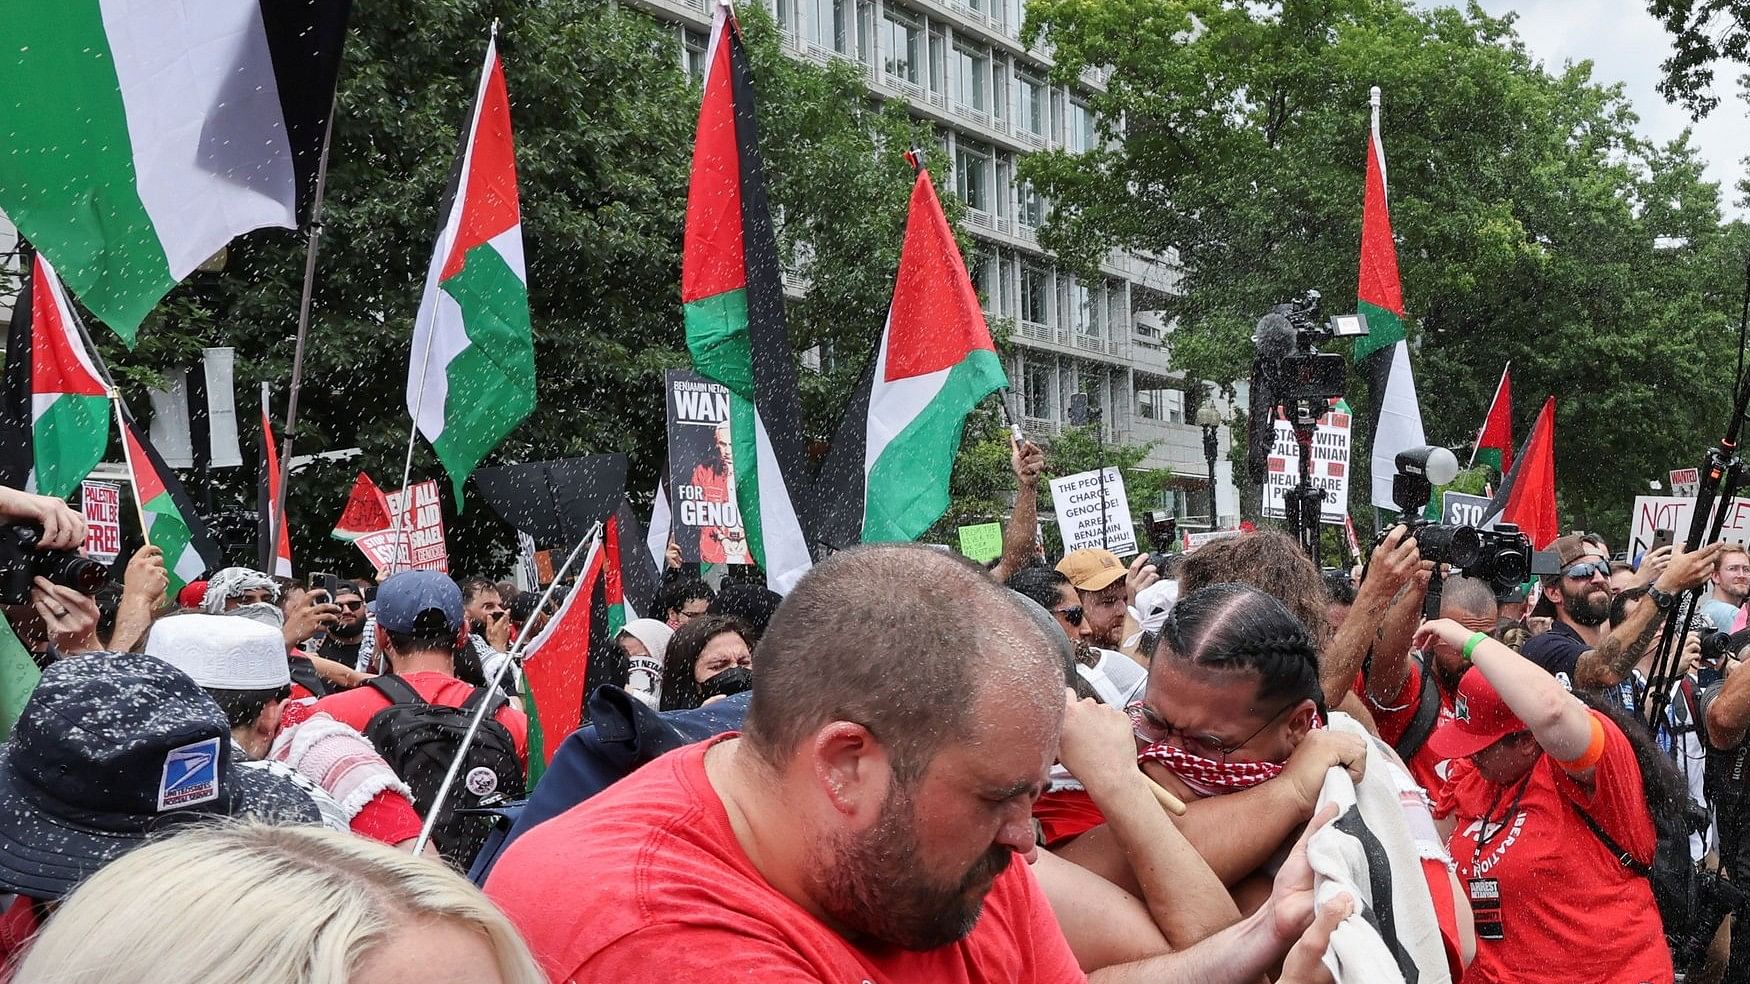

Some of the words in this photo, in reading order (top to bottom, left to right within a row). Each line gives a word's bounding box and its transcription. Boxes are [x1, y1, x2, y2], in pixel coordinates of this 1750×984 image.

[674, 380, 707, 393] BENJAMIN
[675, 391, 731, 421] WAN
[1316, 432, 1346, 447] WITH
[1272, 443, 1348, 462] PALEINIAN
[1671, 470, 1697, 484] WANTED
[85, 487, 118, 504] PALESTINE
[415, 482, 436, 508] ALL
[678, 485, 704, 500] FOR
[1058, 482, 1077, 493] THE
[86, 503, 107, 522] WILL
[108, 505, 118, 523] BE
[417, 504, 440, 530] AID
[1066, 498, 1119, 518] GENOCDE!
[1640, 502, 1687, 535] NOT
[363, 535, 385, 548] STOP
[1732, 747, 1748, 780] Canon
[1470, 881, 1498, 891] ARREST
